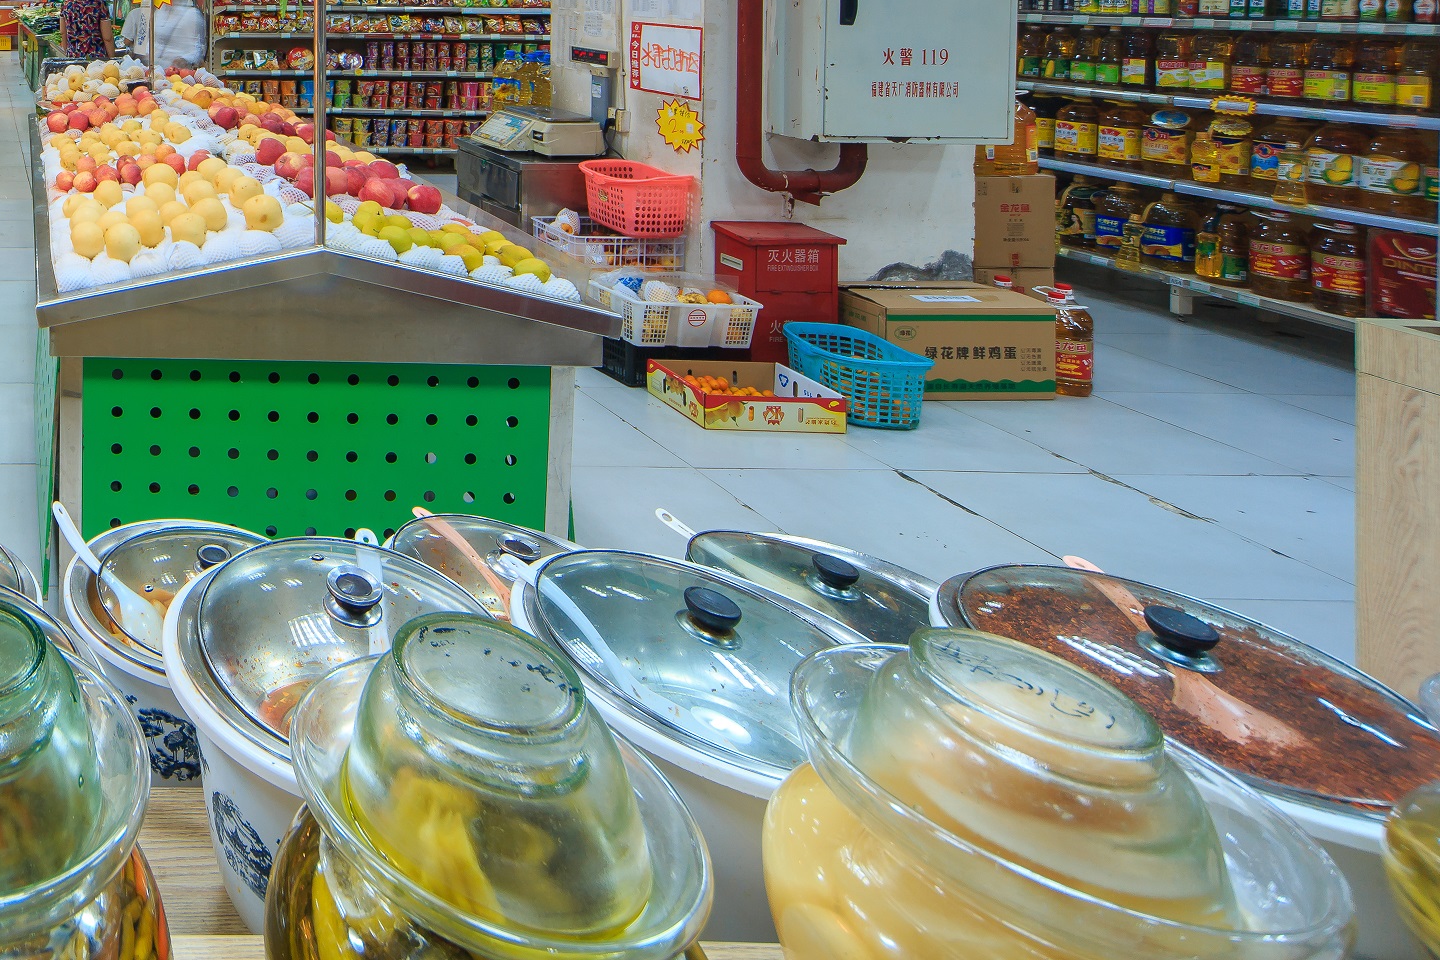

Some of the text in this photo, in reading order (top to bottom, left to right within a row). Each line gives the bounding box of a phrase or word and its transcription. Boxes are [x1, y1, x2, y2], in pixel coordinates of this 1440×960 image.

[882, 48, 949, 66] 火警 119
[767, 248, 820, 264] 灭火器箱
[767, 264, 819, 272] FIRE EXTINGUISHER BOX
[925, 346, 1017, 360] 绿花牌鲜鸡蛋
